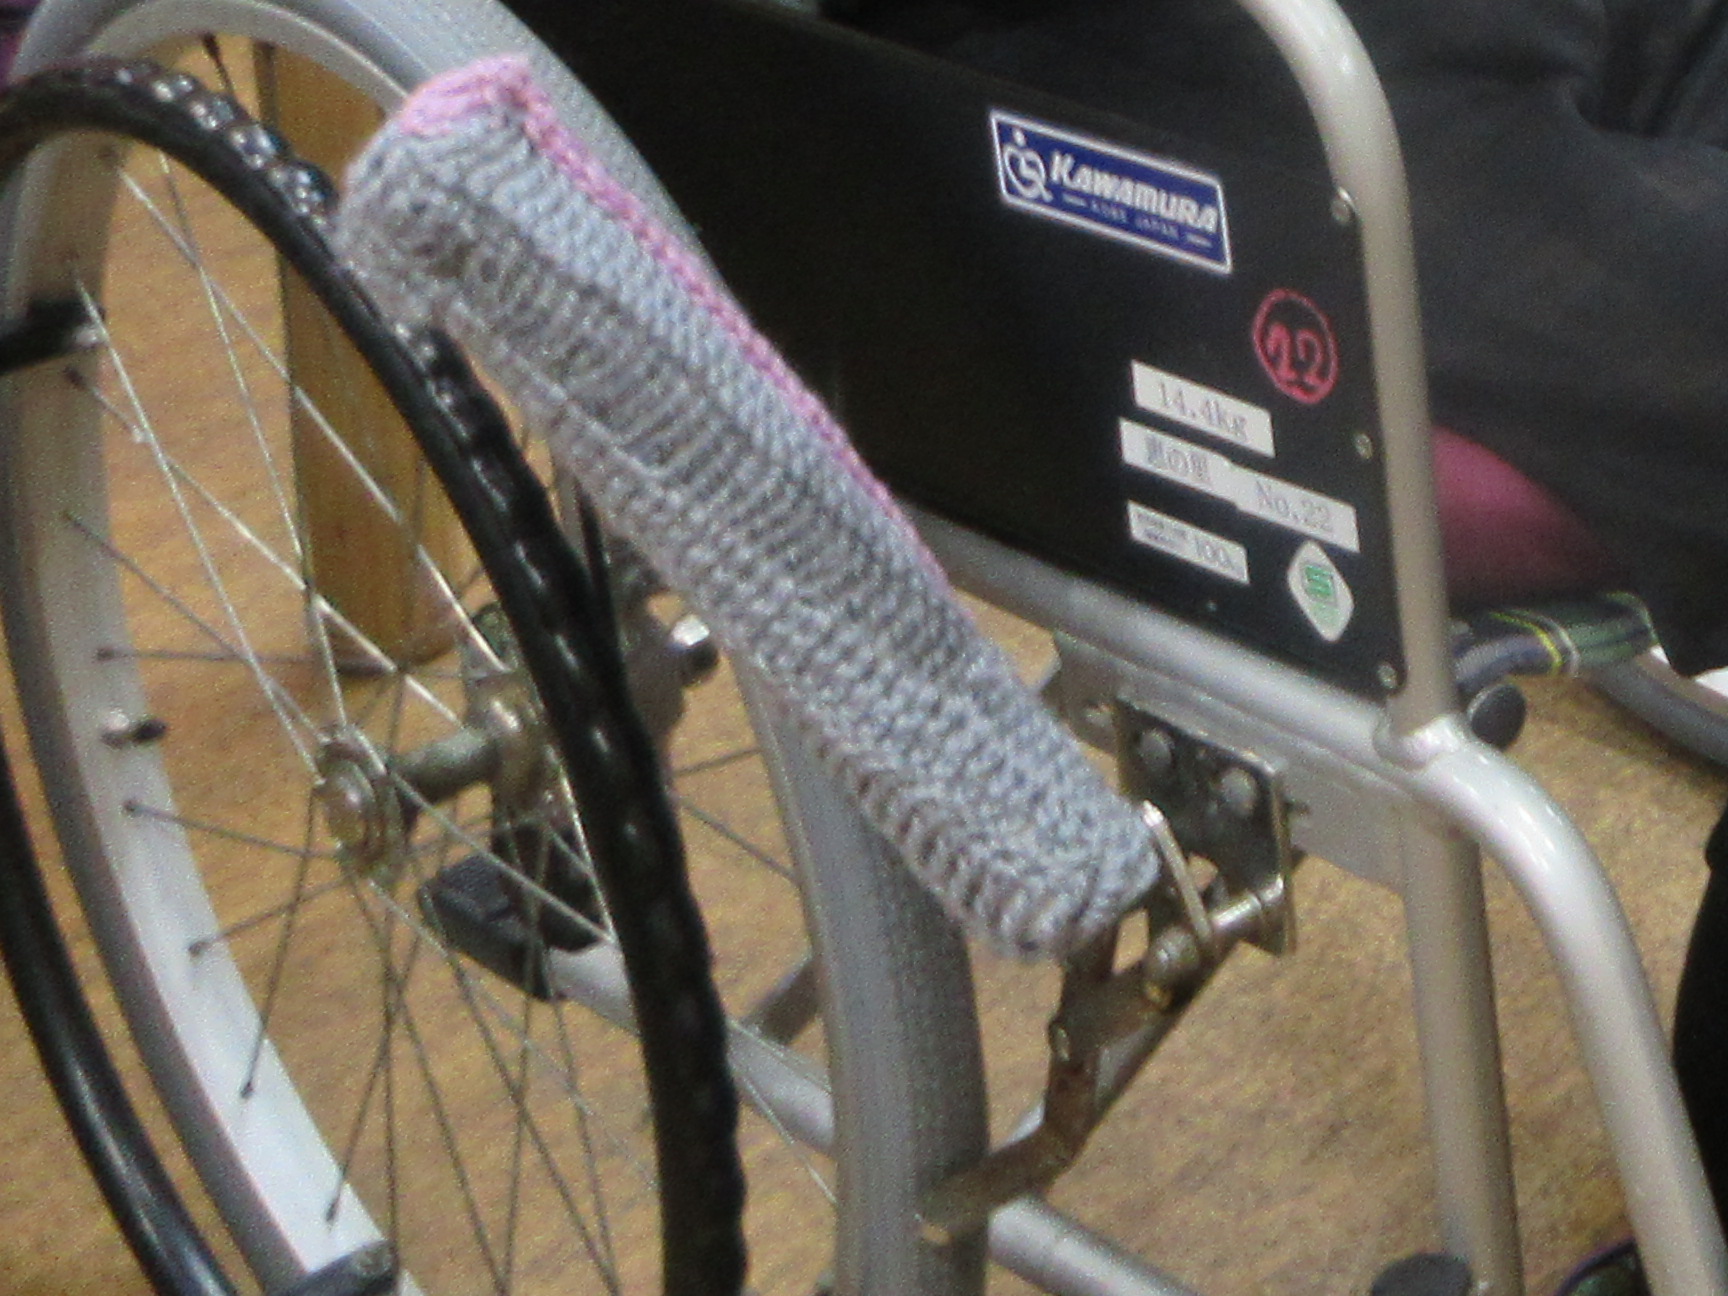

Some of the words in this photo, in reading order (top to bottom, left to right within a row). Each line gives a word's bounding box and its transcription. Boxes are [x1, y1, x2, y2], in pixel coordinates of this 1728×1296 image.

[1050, 149, 1219, 233] KAWAMURA
[1158, 378, 1248, 442] 14.4kg
[1254, 478, 1335, 534] No.22
